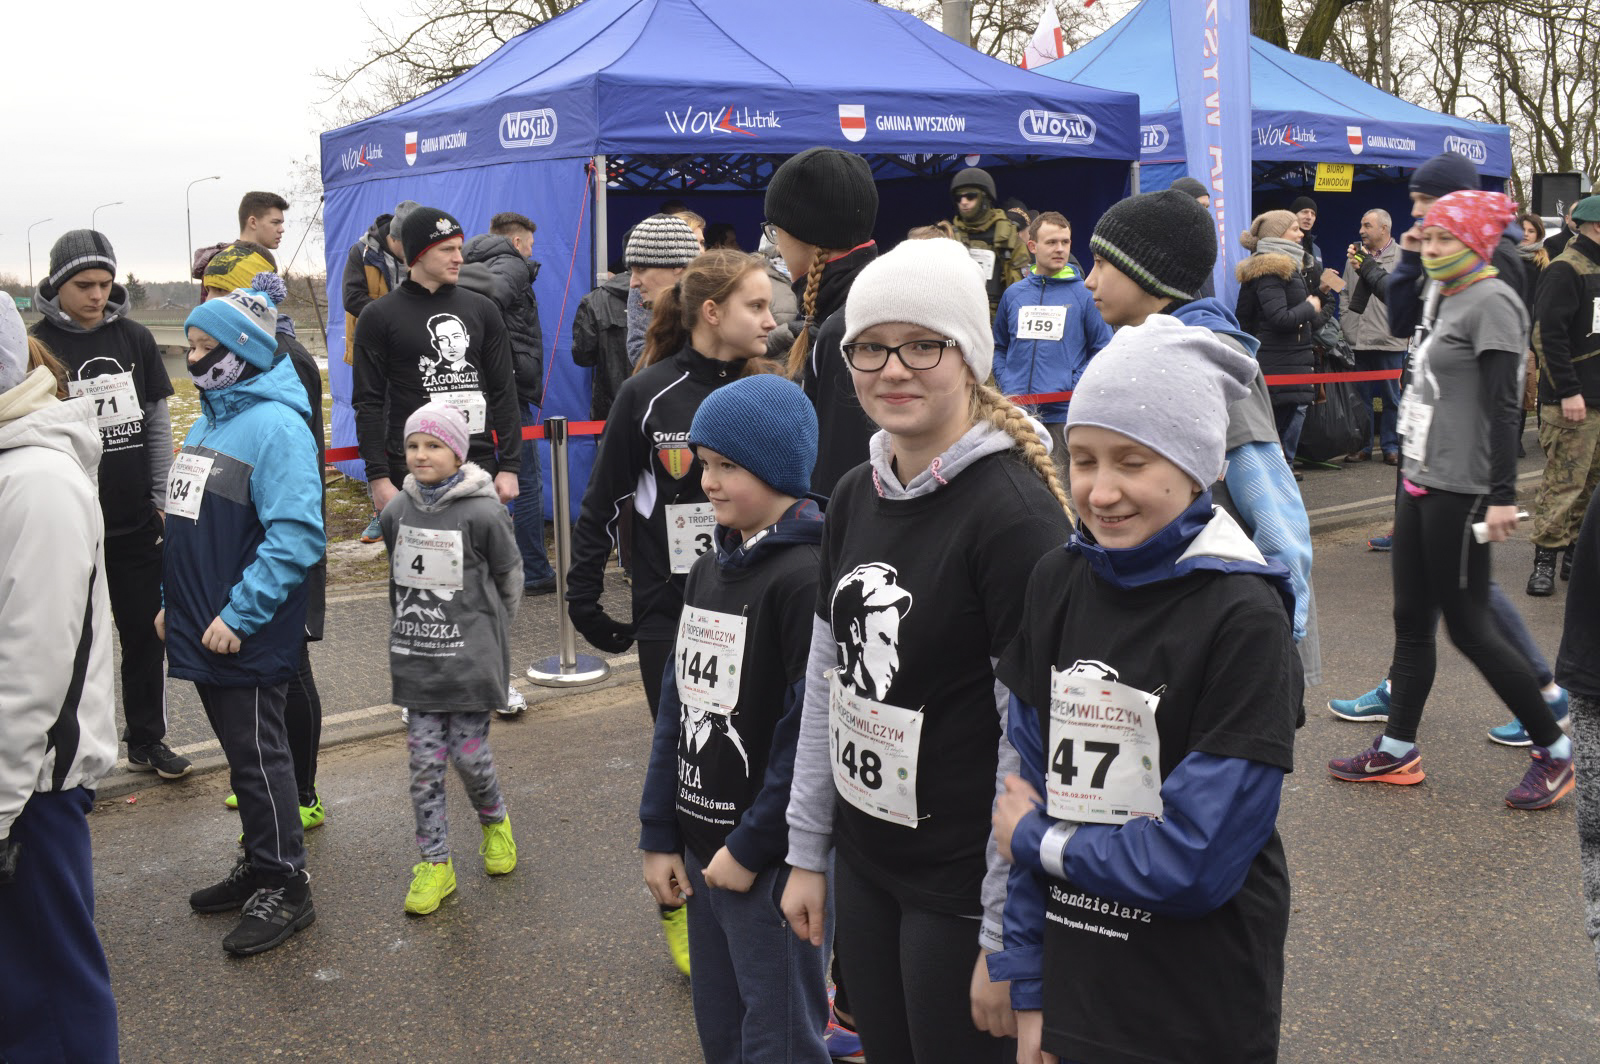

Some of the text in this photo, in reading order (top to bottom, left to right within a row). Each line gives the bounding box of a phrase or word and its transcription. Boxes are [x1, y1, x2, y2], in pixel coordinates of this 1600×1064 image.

[736, 107, 781, 129] Hutnik
[875, 114, 966, 132] GMINA WYSZKÓW
[421, 130, 468, 153] GMINA WYSZKÓW
[1367, 136, 1416, 151] GMINA WYSZKÓW
[1326, 164, 1345, 175] BIURO
[1317, 177, 1350, 187] ZAWODÓW
[1026, 319, 1053, 332] 159
[94, 396, 119, 416] 71
[169, 477, 191, 501] 134
[411, 554, 425, 575] 4
[681, 647, 719, 689] 144
[834, 726, 883, 790] 148
[1051, 738, 1121, 790] 47
[680, 787, 736, 811] Siedzikówna
[1051, 885, 1152, 923] Szendzielarz
[1099, 926, 1129, 941] Krajowej
